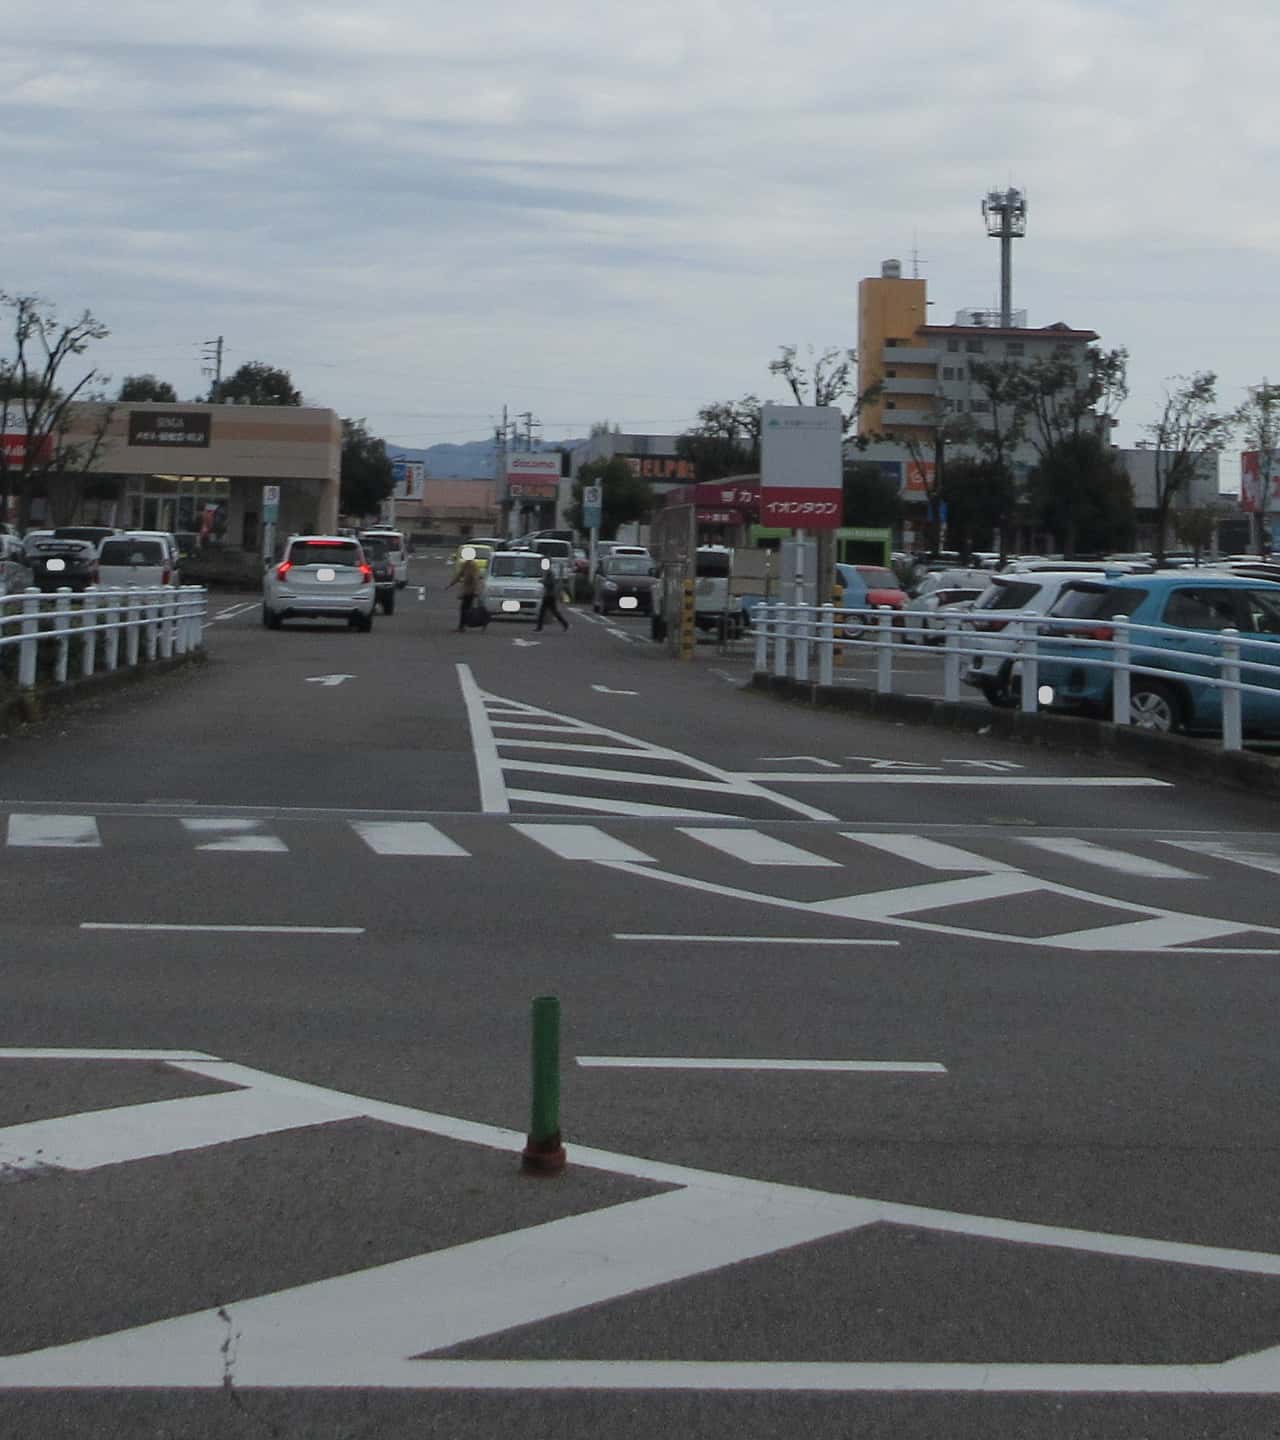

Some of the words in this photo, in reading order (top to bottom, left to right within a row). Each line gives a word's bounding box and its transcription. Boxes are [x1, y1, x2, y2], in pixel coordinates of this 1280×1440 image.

[767, 501, 839, 515] イオンタウン
